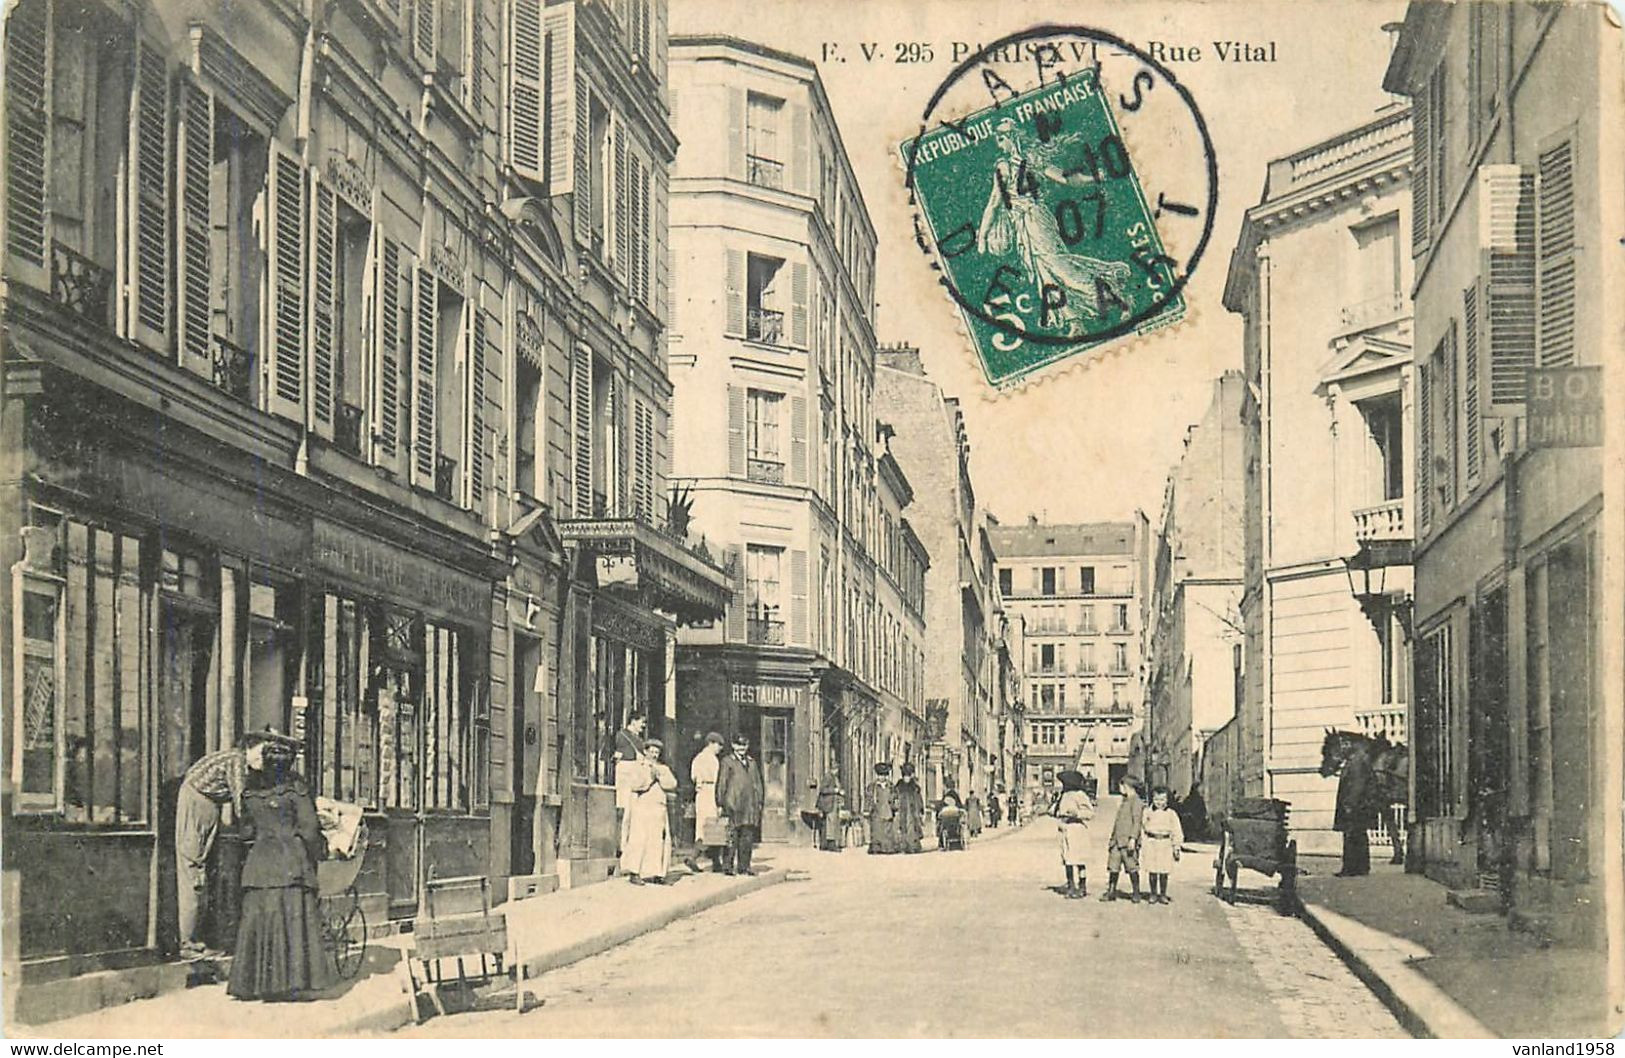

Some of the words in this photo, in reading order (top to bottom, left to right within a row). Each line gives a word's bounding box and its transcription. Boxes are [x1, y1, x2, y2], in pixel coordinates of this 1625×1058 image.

[1014, 79, 1096, 124] FRANÇAISE
[995, 159, 1041, 211] 14
[1055, 191, 1106, 246] 07
[732, 684, 803, 705] RESTAURANT
